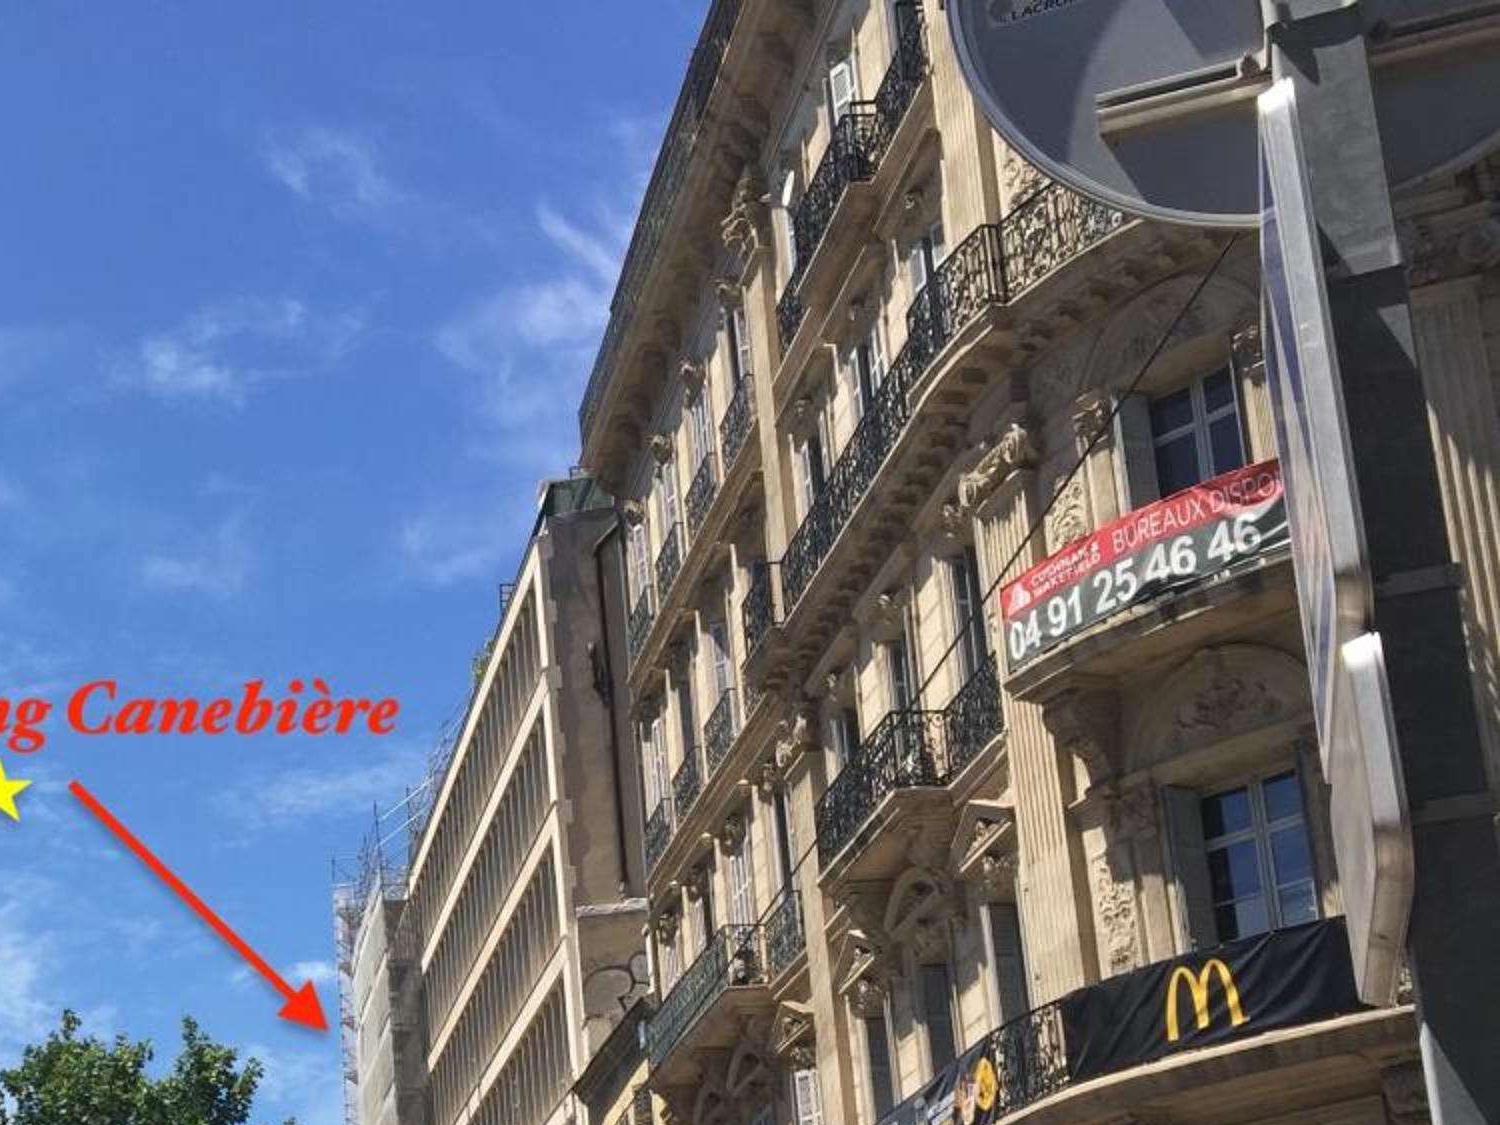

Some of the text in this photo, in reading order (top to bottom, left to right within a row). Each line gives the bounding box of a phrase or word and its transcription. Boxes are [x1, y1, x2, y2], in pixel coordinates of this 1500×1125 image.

[1111, 472, 1278, 554] BUREAUX DISPO
[1009, 512, 1262, 661] 04 91 25 46 46
